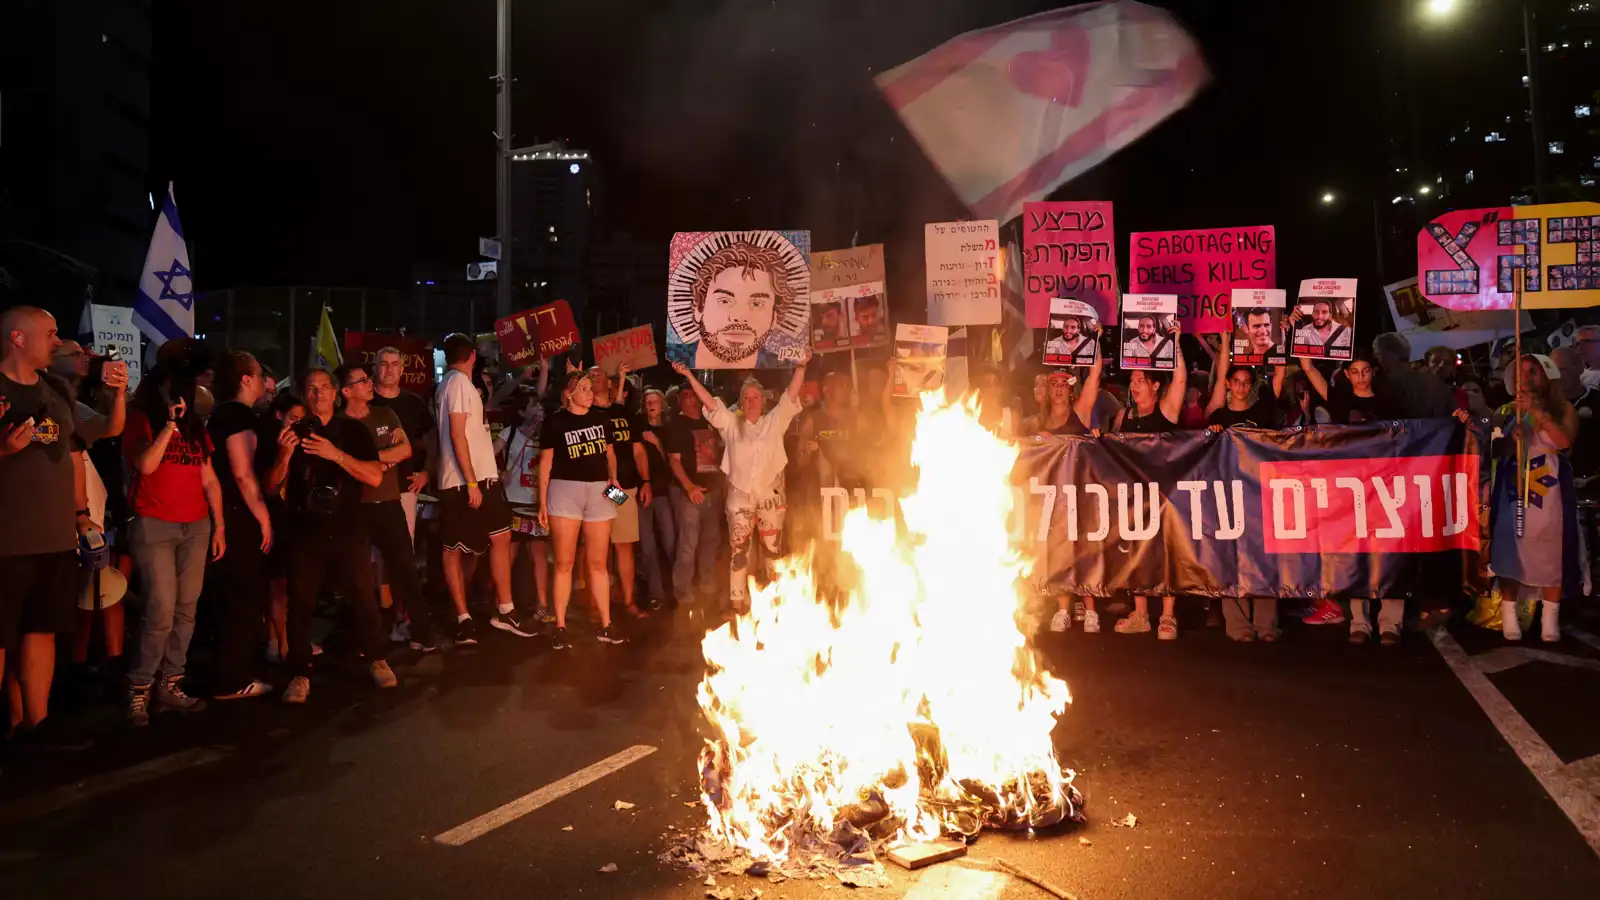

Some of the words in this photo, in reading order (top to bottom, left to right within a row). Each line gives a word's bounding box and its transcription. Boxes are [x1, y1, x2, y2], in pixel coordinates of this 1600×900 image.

[934, 225, 946, 234] על
[950, 225, 990, 234] החטופים
[1031, 210, 1106, 232] מבצע
[1033, 242, 1111, 267] הפקרת
[1136, 230, 1272, 258] SABOTAGING
[1136, 263, 1195, 285] DEALS
[1208, 259, 1268, 283] KILLS
[1028, 273, 1112, 294] החטופים
[98, 331, 133, 342] תמיכה
[779, 346, 801, 360] אלון
[1176, 479, 1245, 540] עד
[1269, 472, 1469, 538] עוצרים
